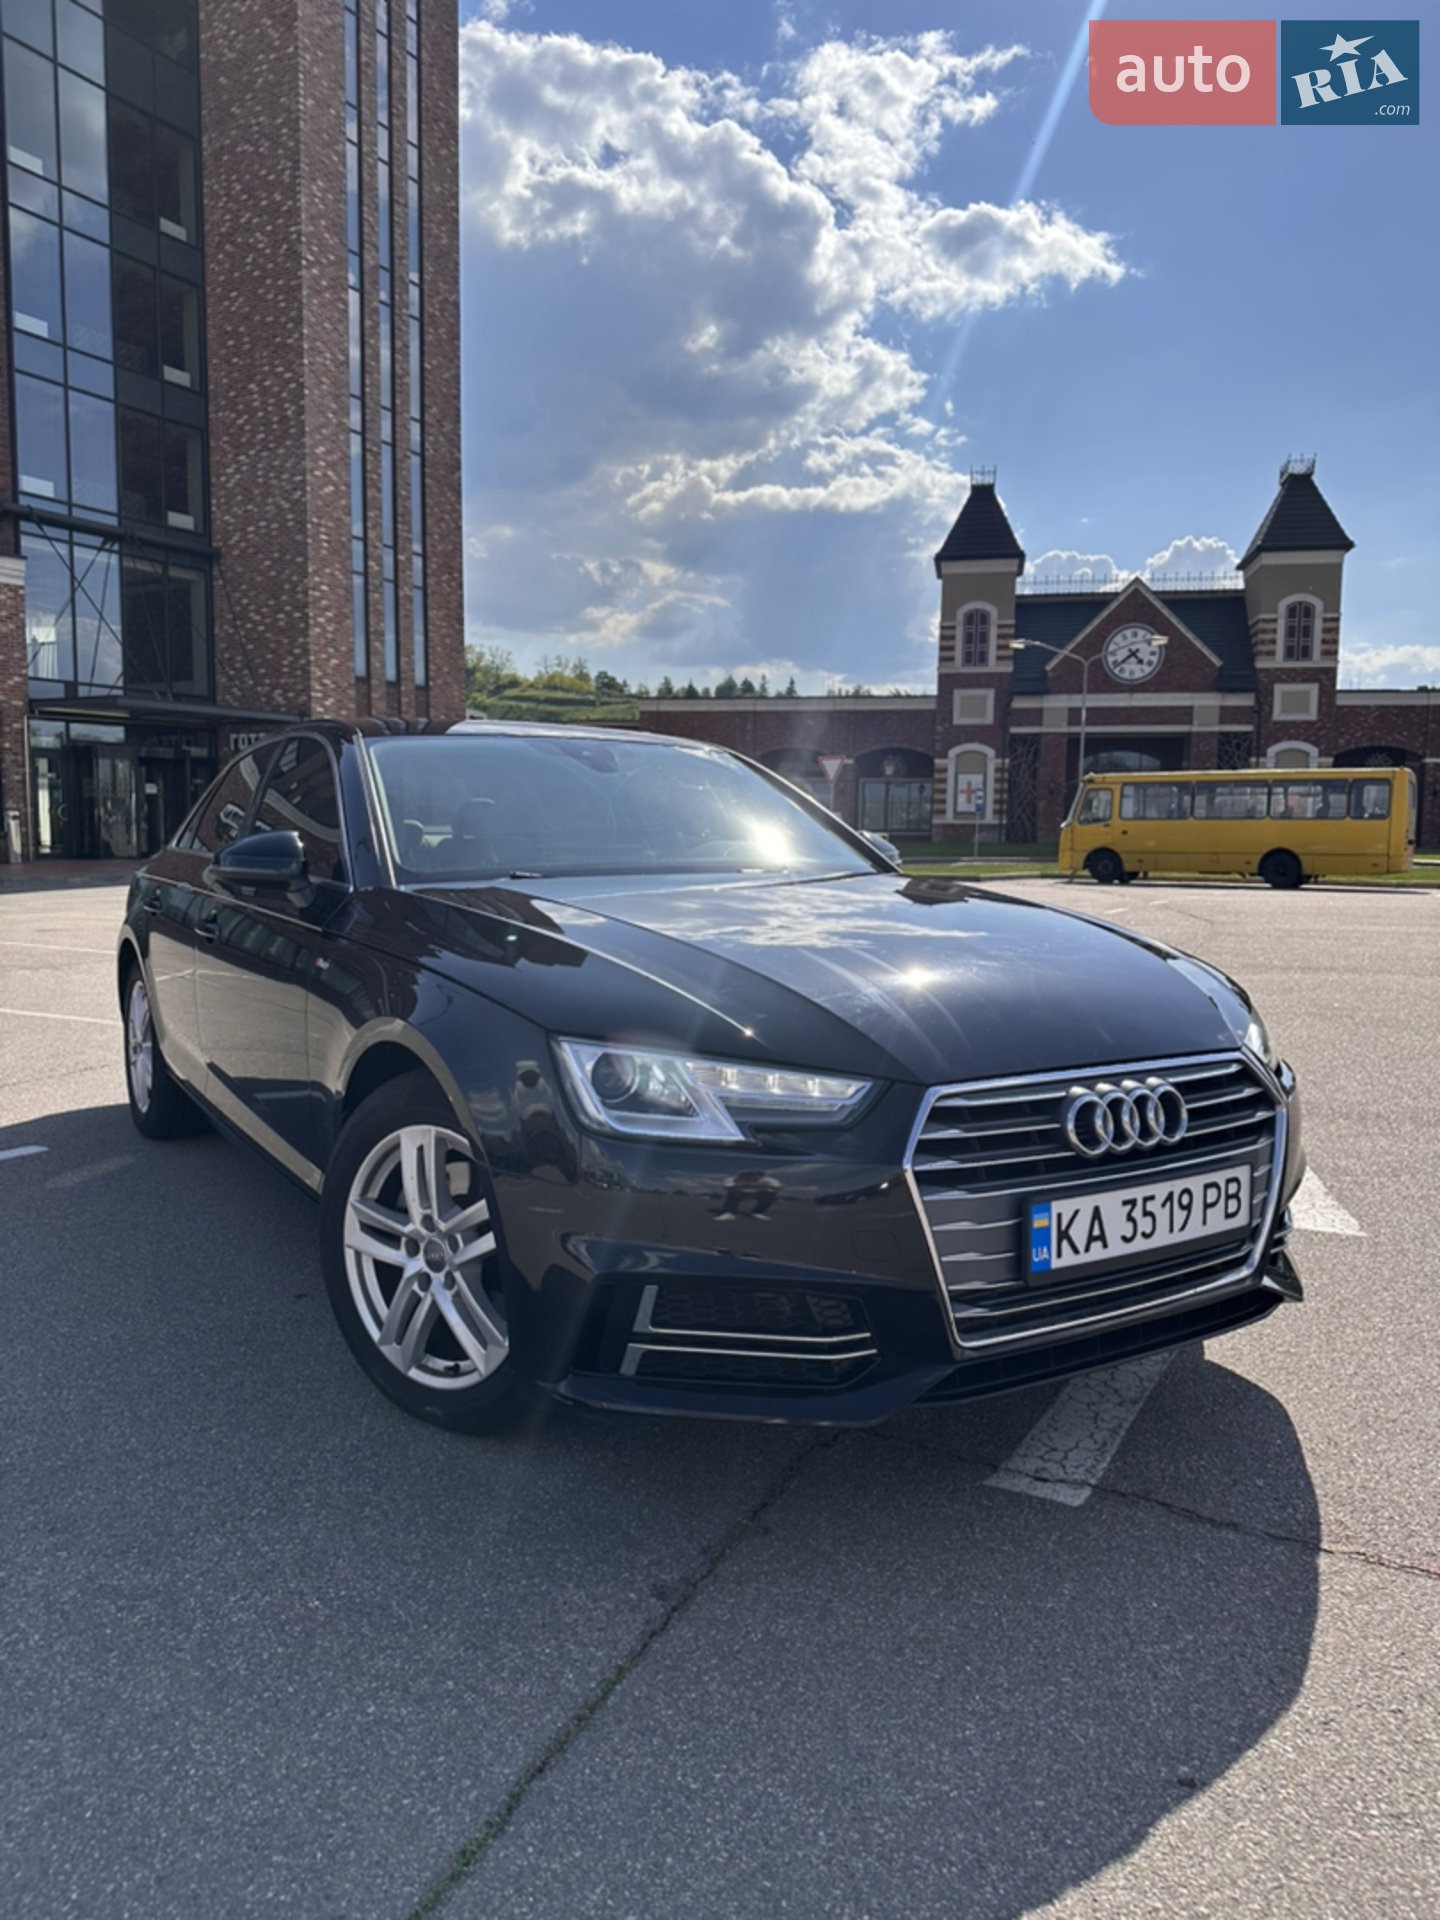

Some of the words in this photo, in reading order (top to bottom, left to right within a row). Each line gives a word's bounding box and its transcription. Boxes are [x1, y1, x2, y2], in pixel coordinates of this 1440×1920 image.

[1056, 1204, 1109, 1259] KA
[1119, 1187, 1194, 1244] 3519
[1202, 1176, 1243, 1226] PB
[1032, 1245, 1049, 1262] UA
